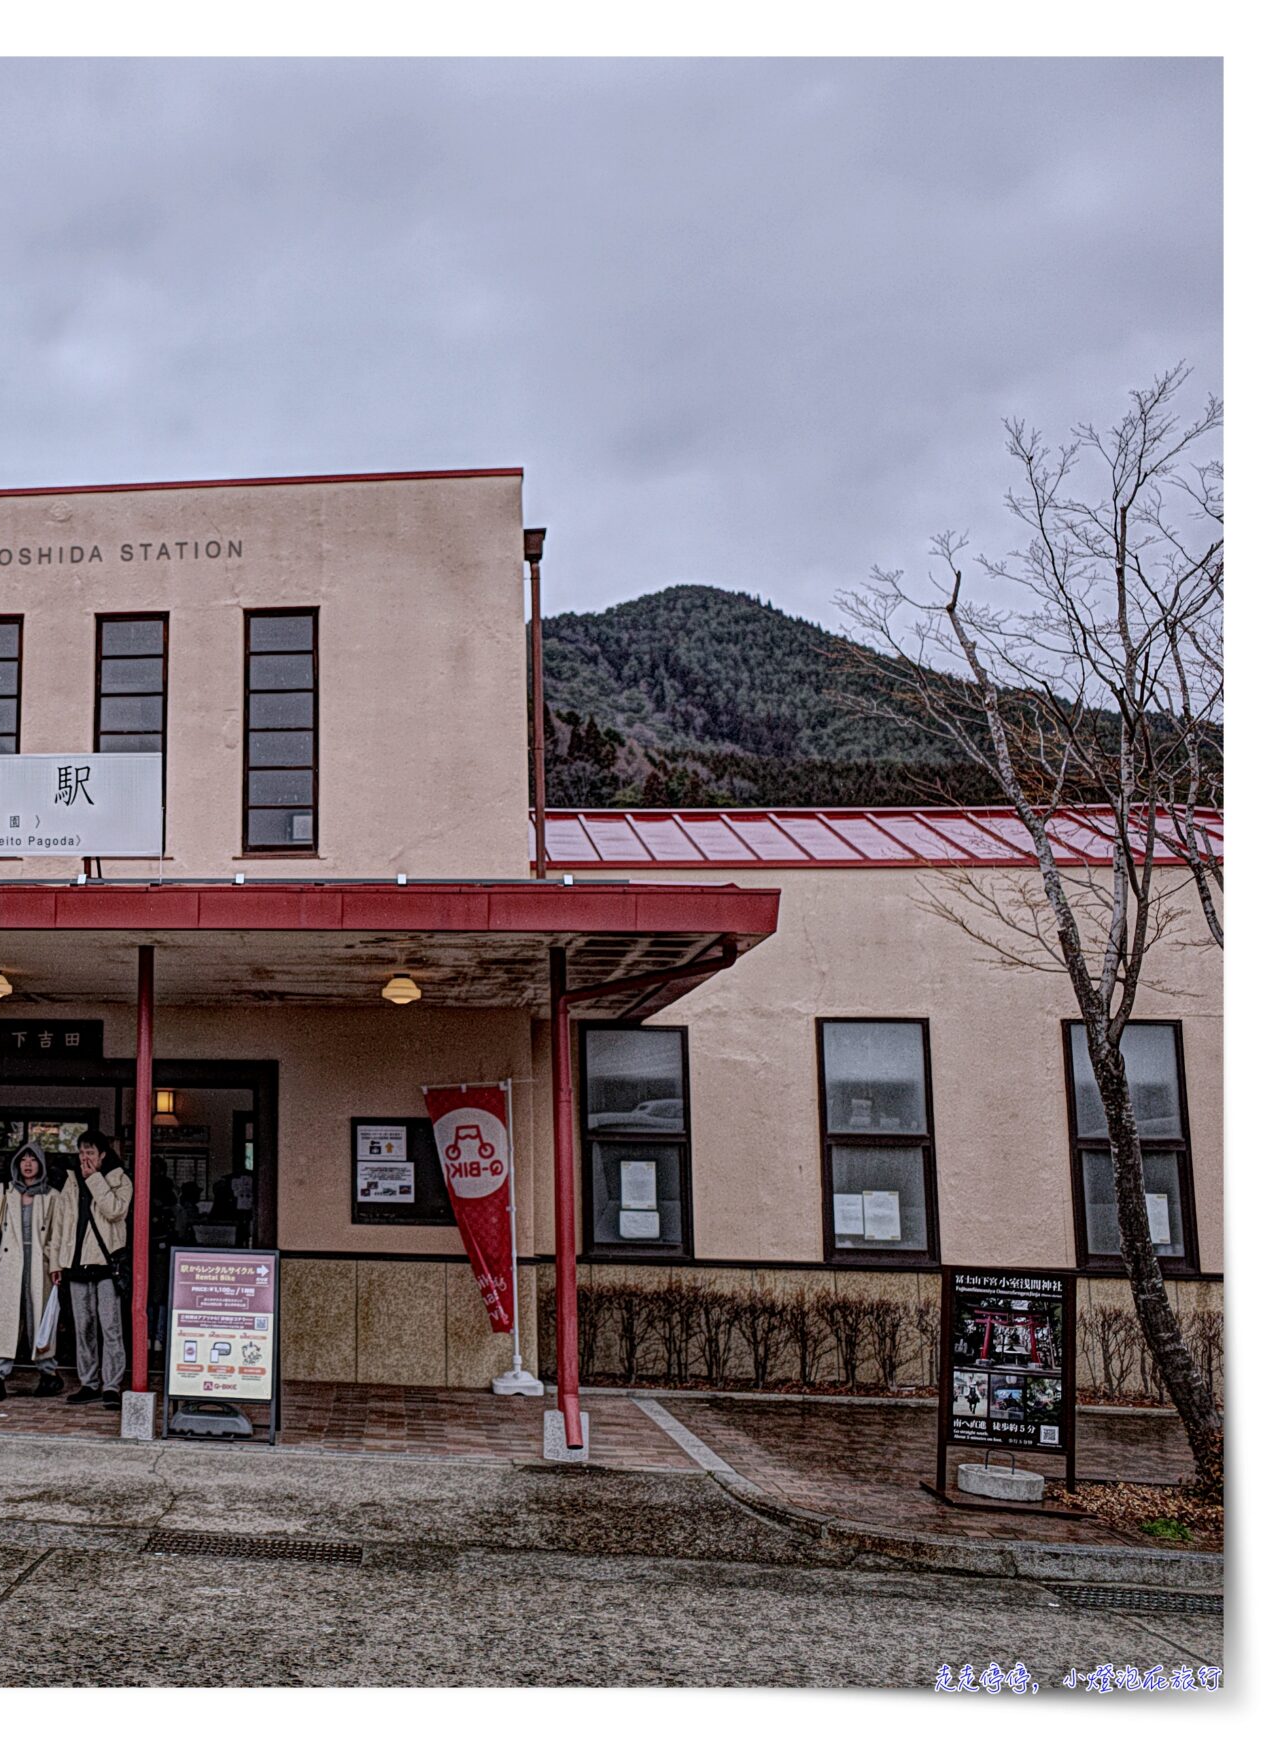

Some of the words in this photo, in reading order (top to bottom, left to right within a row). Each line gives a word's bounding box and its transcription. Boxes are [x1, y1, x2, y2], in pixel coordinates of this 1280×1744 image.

[120, 540, 243, 562] STATION
[11, 1030, 80, 1048] 下吉田
[180, 1264, 255, 1275] 駅からレンタルサイクル
[953, 1419, 987, 1430] 南へ直進
